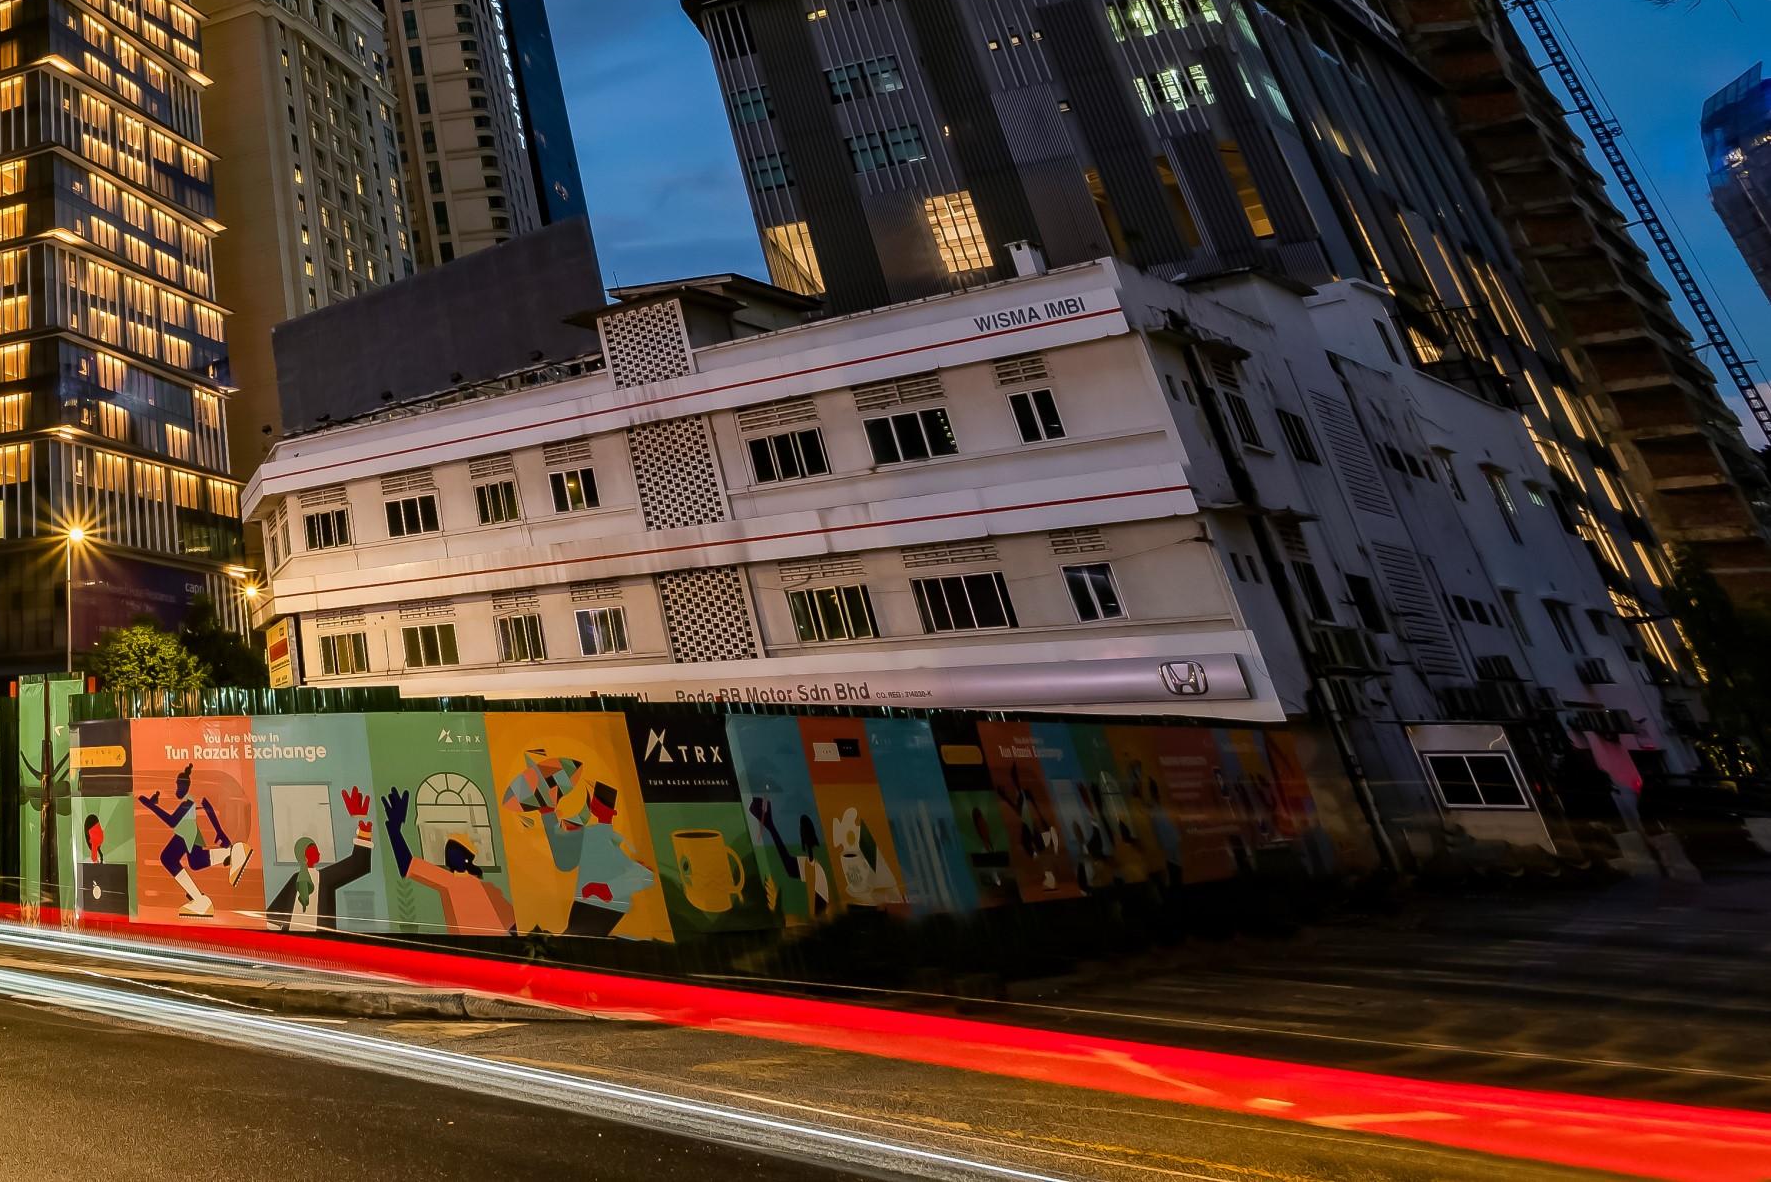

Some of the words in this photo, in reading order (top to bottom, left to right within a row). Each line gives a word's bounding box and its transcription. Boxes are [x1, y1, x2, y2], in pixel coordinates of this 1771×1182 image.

[495, 14, 526, 150] DORSETT
[974, 307, 1041, 332] WISMA
[1044, 297, 1086, 319] IMBI
[745, 686, 793, 703] Motor
[797, 684, 831, 702] Sdn
[834, 682, 870, 701] Bhd
[203, 733, 221, 744] You
[224, 733, 241, 743] Are
[243, 733, 266, 743] Now
[269, 733, 279, 743] In
[456, 735, 481, 743] TRX
[165, 745, 189, 760] Tun
[193, 744, 239, 760] Razak
[244, 744, 327, 762] Exchange
[677, 745, 723, 763] TRX
